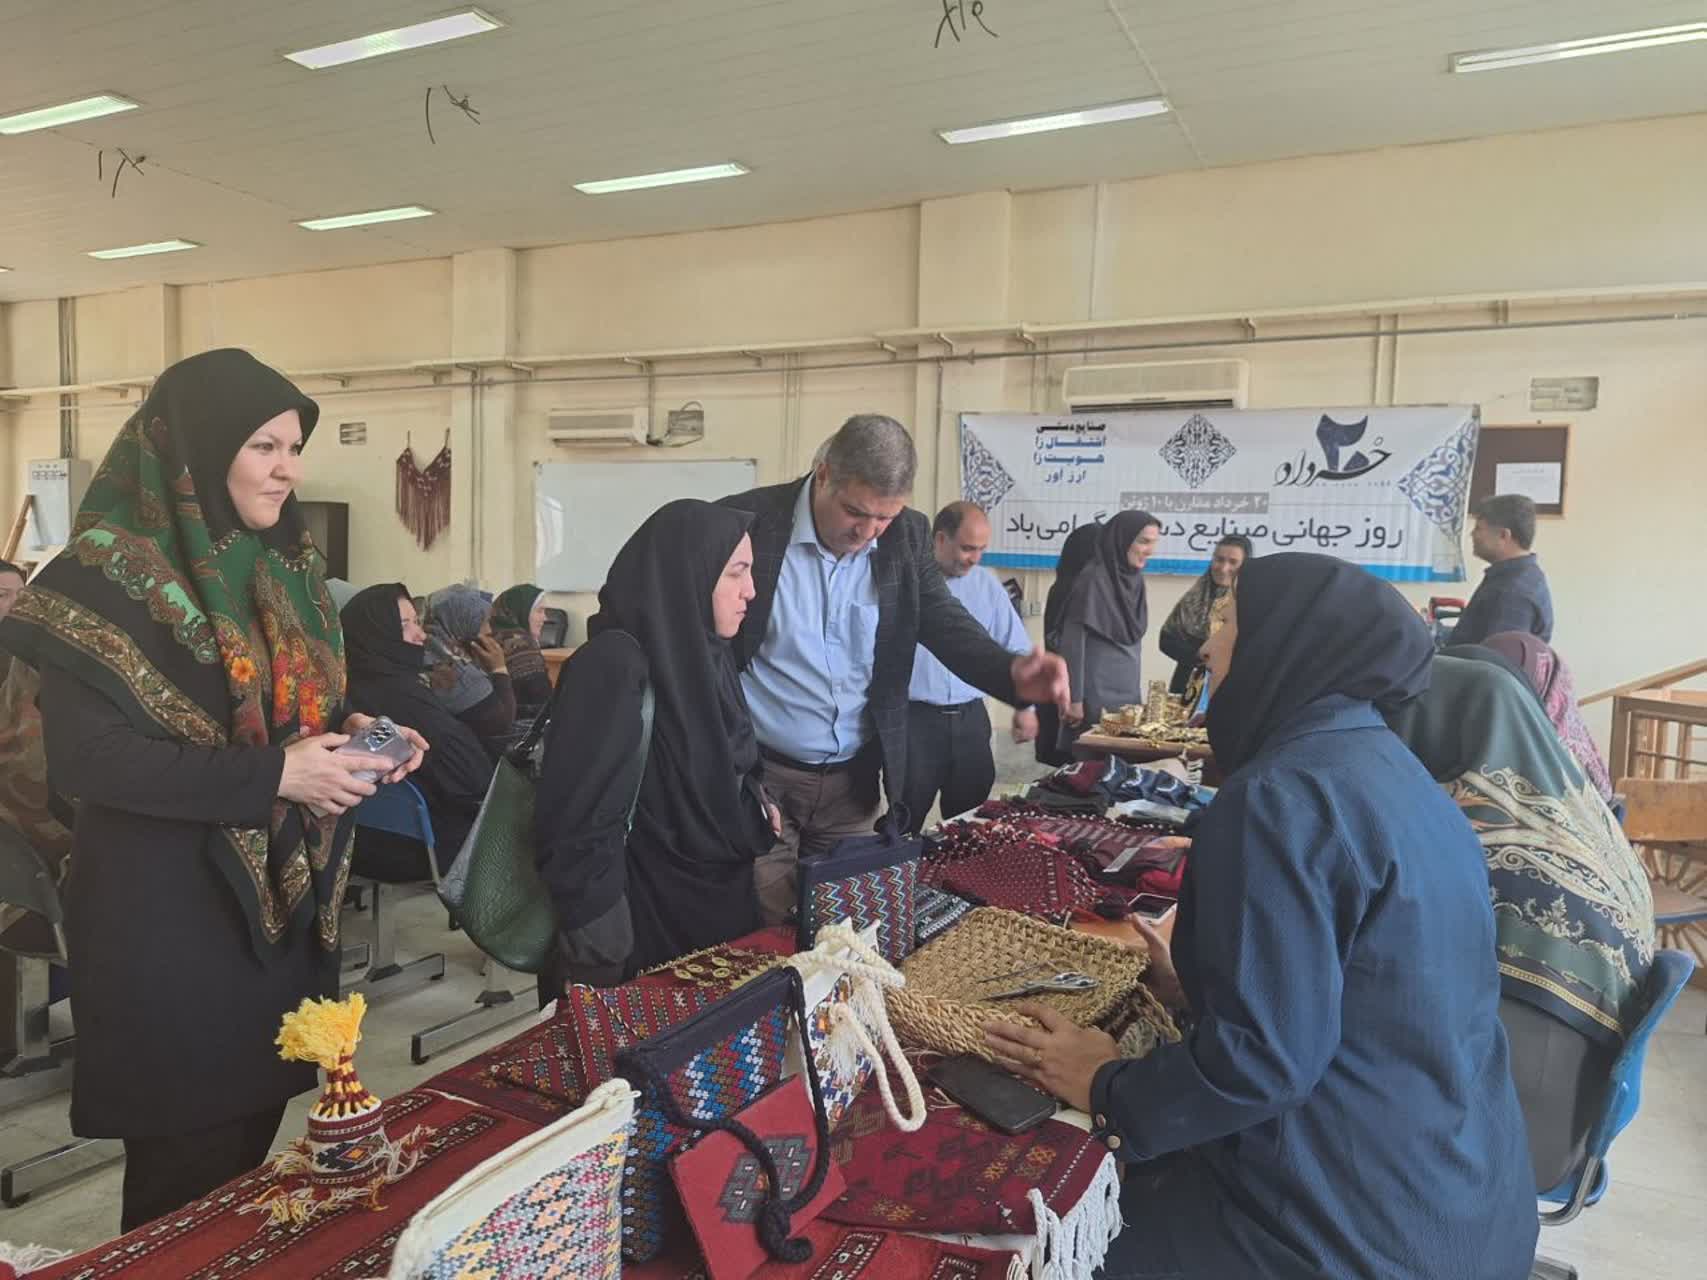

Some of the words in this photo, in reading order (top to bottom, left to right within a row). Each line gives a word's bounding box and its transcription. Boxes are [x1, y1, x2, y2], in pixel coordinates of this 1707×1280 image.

[1213, 495, 1249, 512] خرداد
[1006, 513, 1035, 541] باد
[1187, 516, 1269, 551] صنایع
[1271, 518, 1352, 548] جهانی
[1355, 517, 1403, 549] روز
